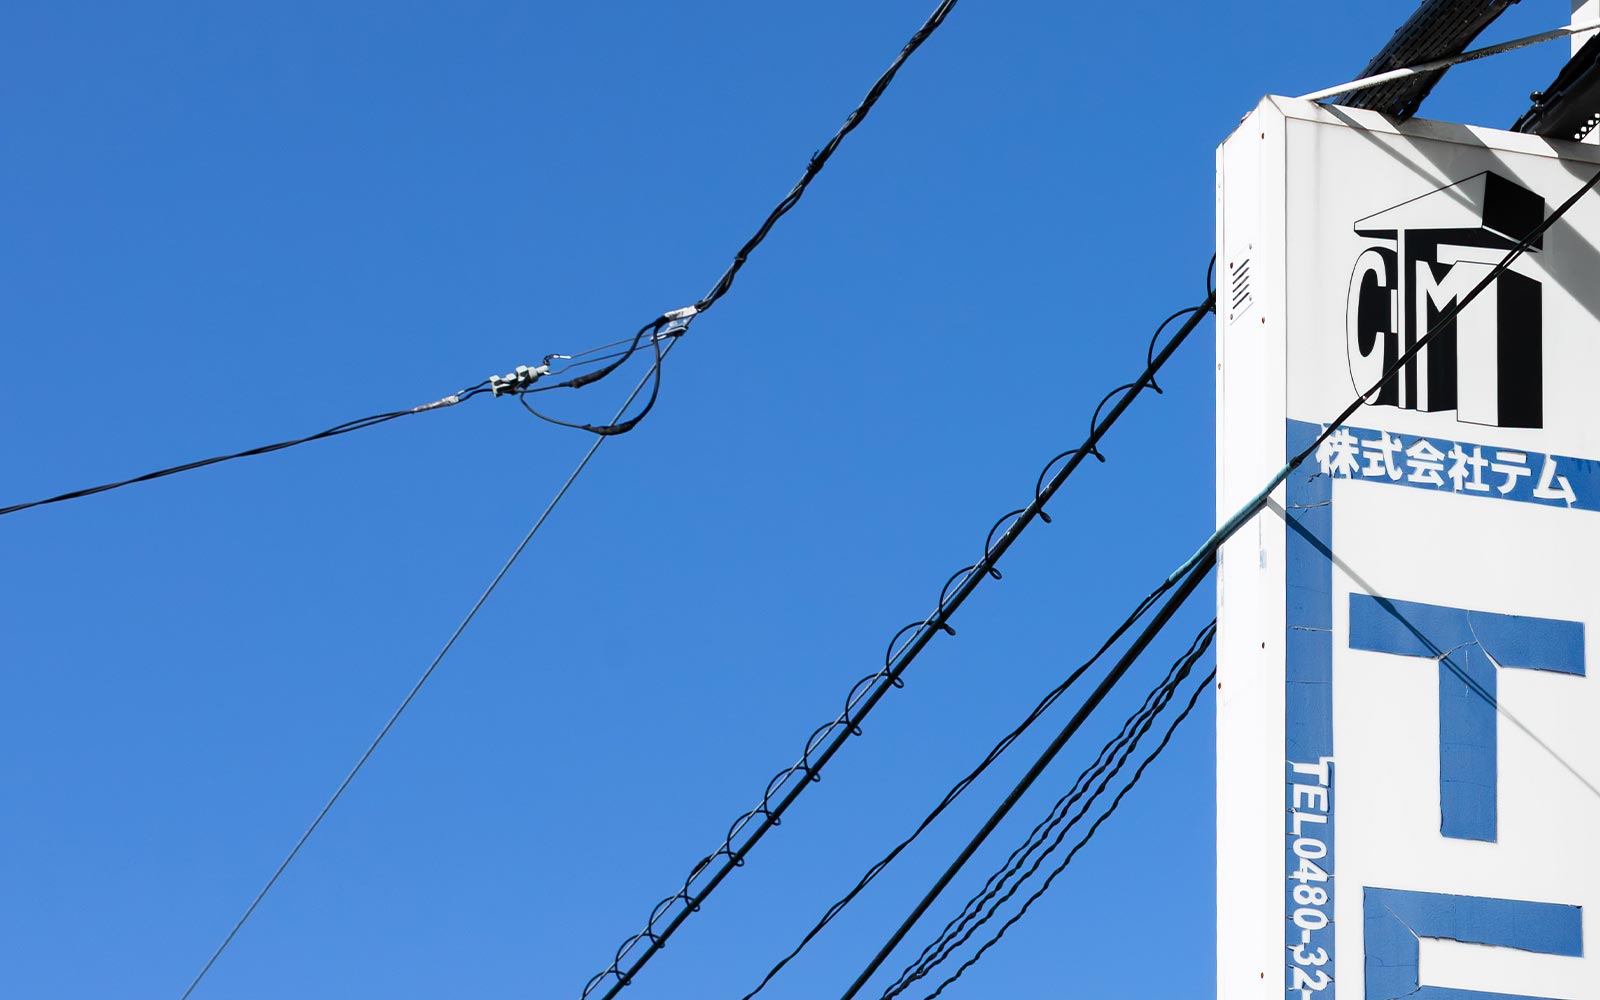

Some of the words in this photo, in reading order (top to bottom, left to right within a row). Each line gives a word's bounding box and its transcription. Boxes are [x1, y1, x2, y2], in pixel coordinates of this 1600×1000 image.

[1315, 430, 1577, 504] 株式会社テム
